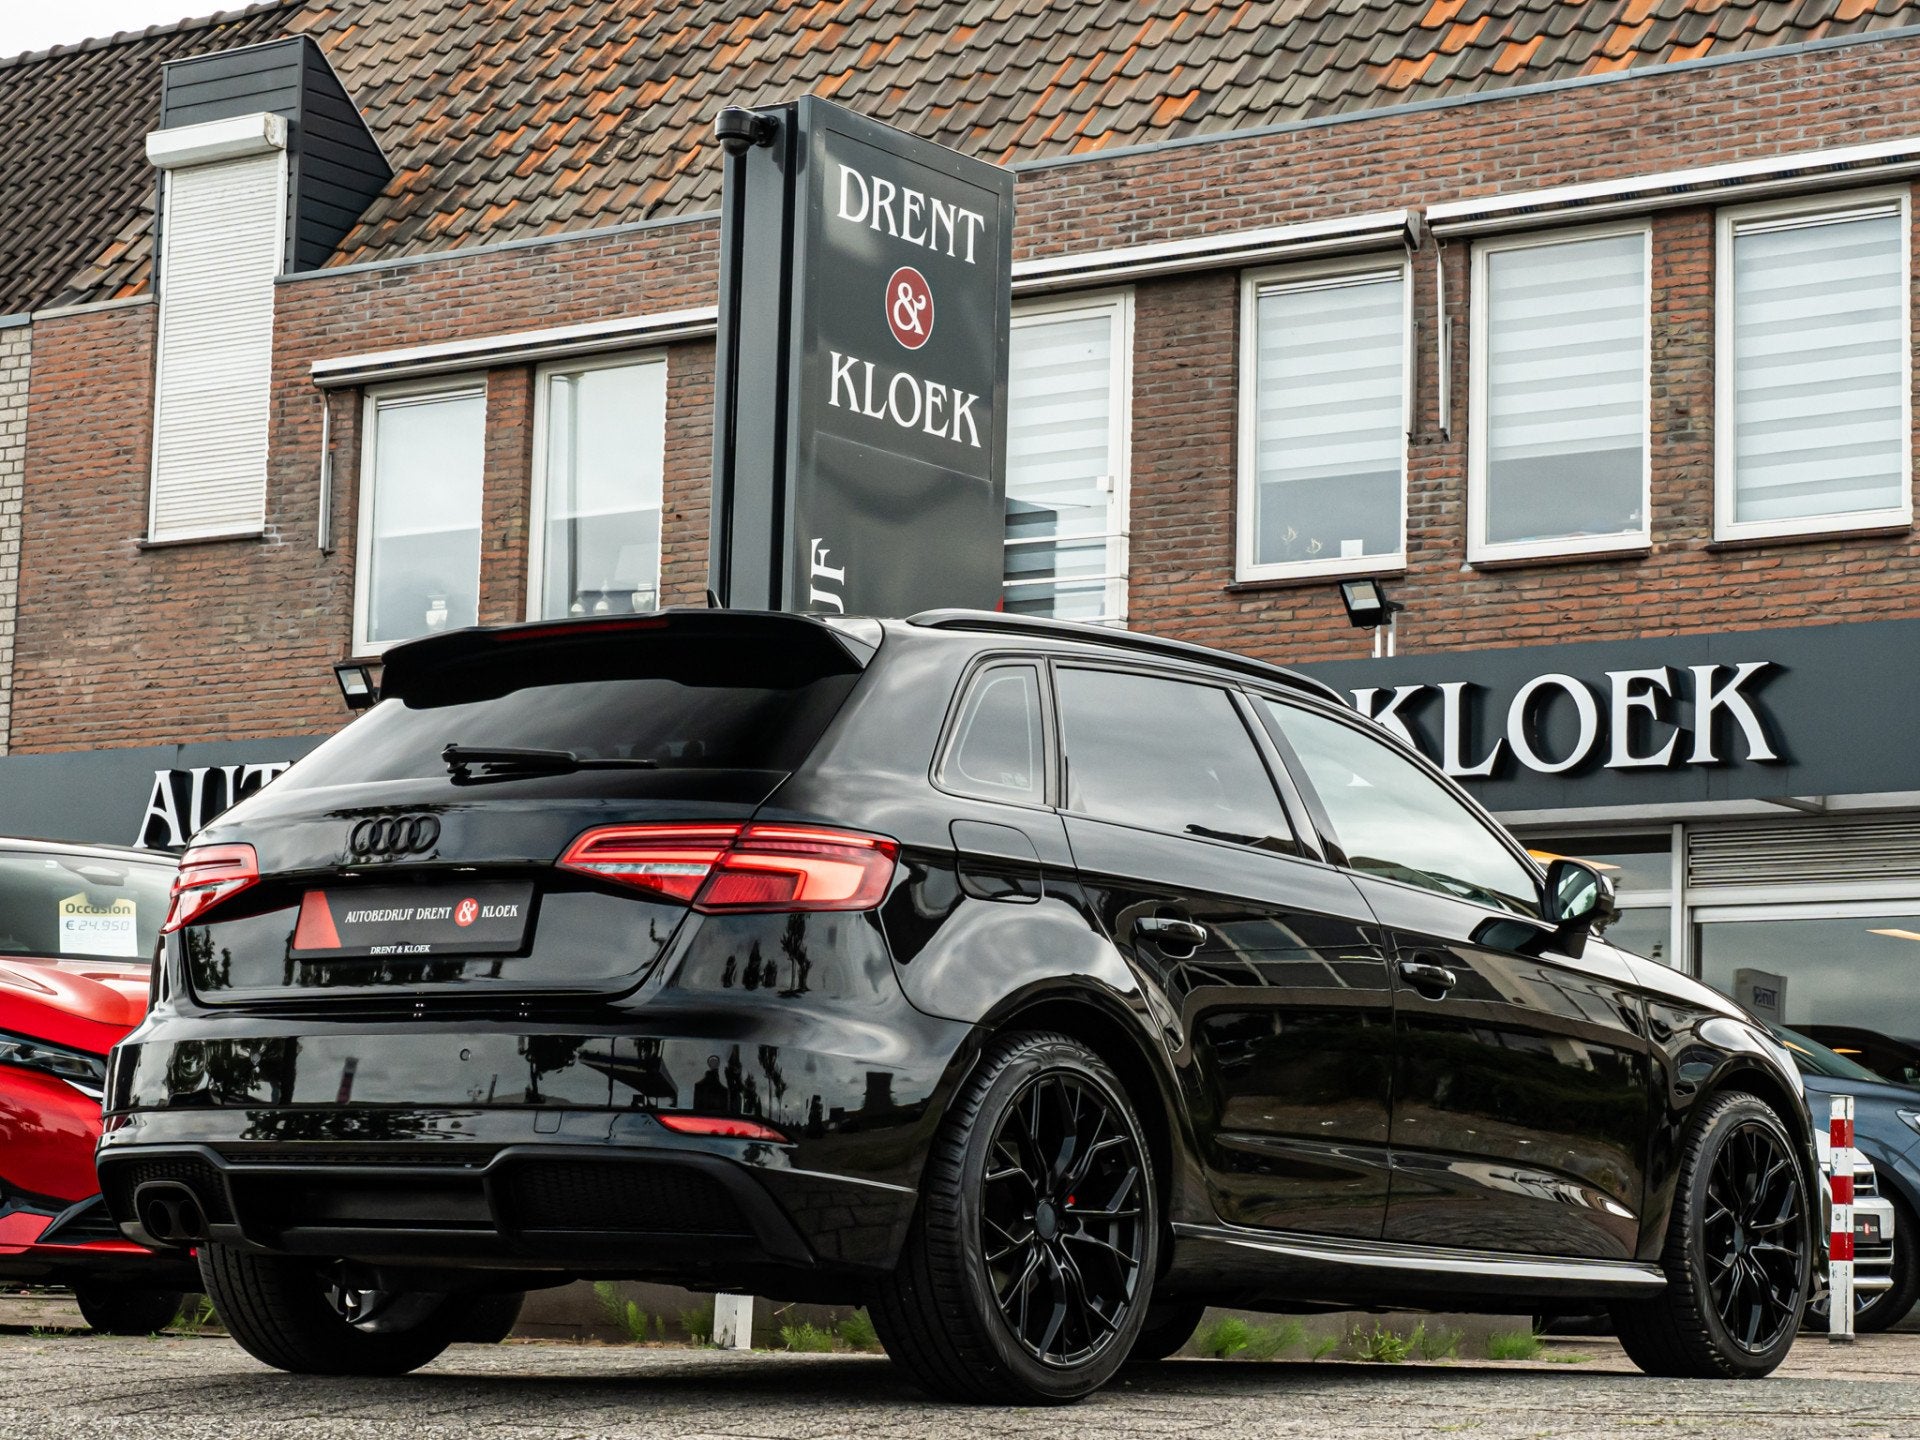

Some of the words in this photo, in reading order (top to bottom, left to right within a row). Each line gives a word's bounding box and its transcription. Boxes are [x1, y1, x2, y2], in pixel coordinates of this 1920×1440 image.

[837, 163, 985, 265] DRENT
[893, 282, 926, 335] &
[828, 351, 982, 448] KLOEK
[1349, 660, 1779, 777] KLOEK
[65, 903, 131, 914] Occasion
[345, 908, 415, 923] AUTOBEDRIJF
[416, 907, 452, 920] DRENT
[458, 901, 476, 922] &
[481, 905, 518, 918] KLOEK
[370, 945, 397, 955] DRENT
[403, 944, 430, 953] KLOEK
